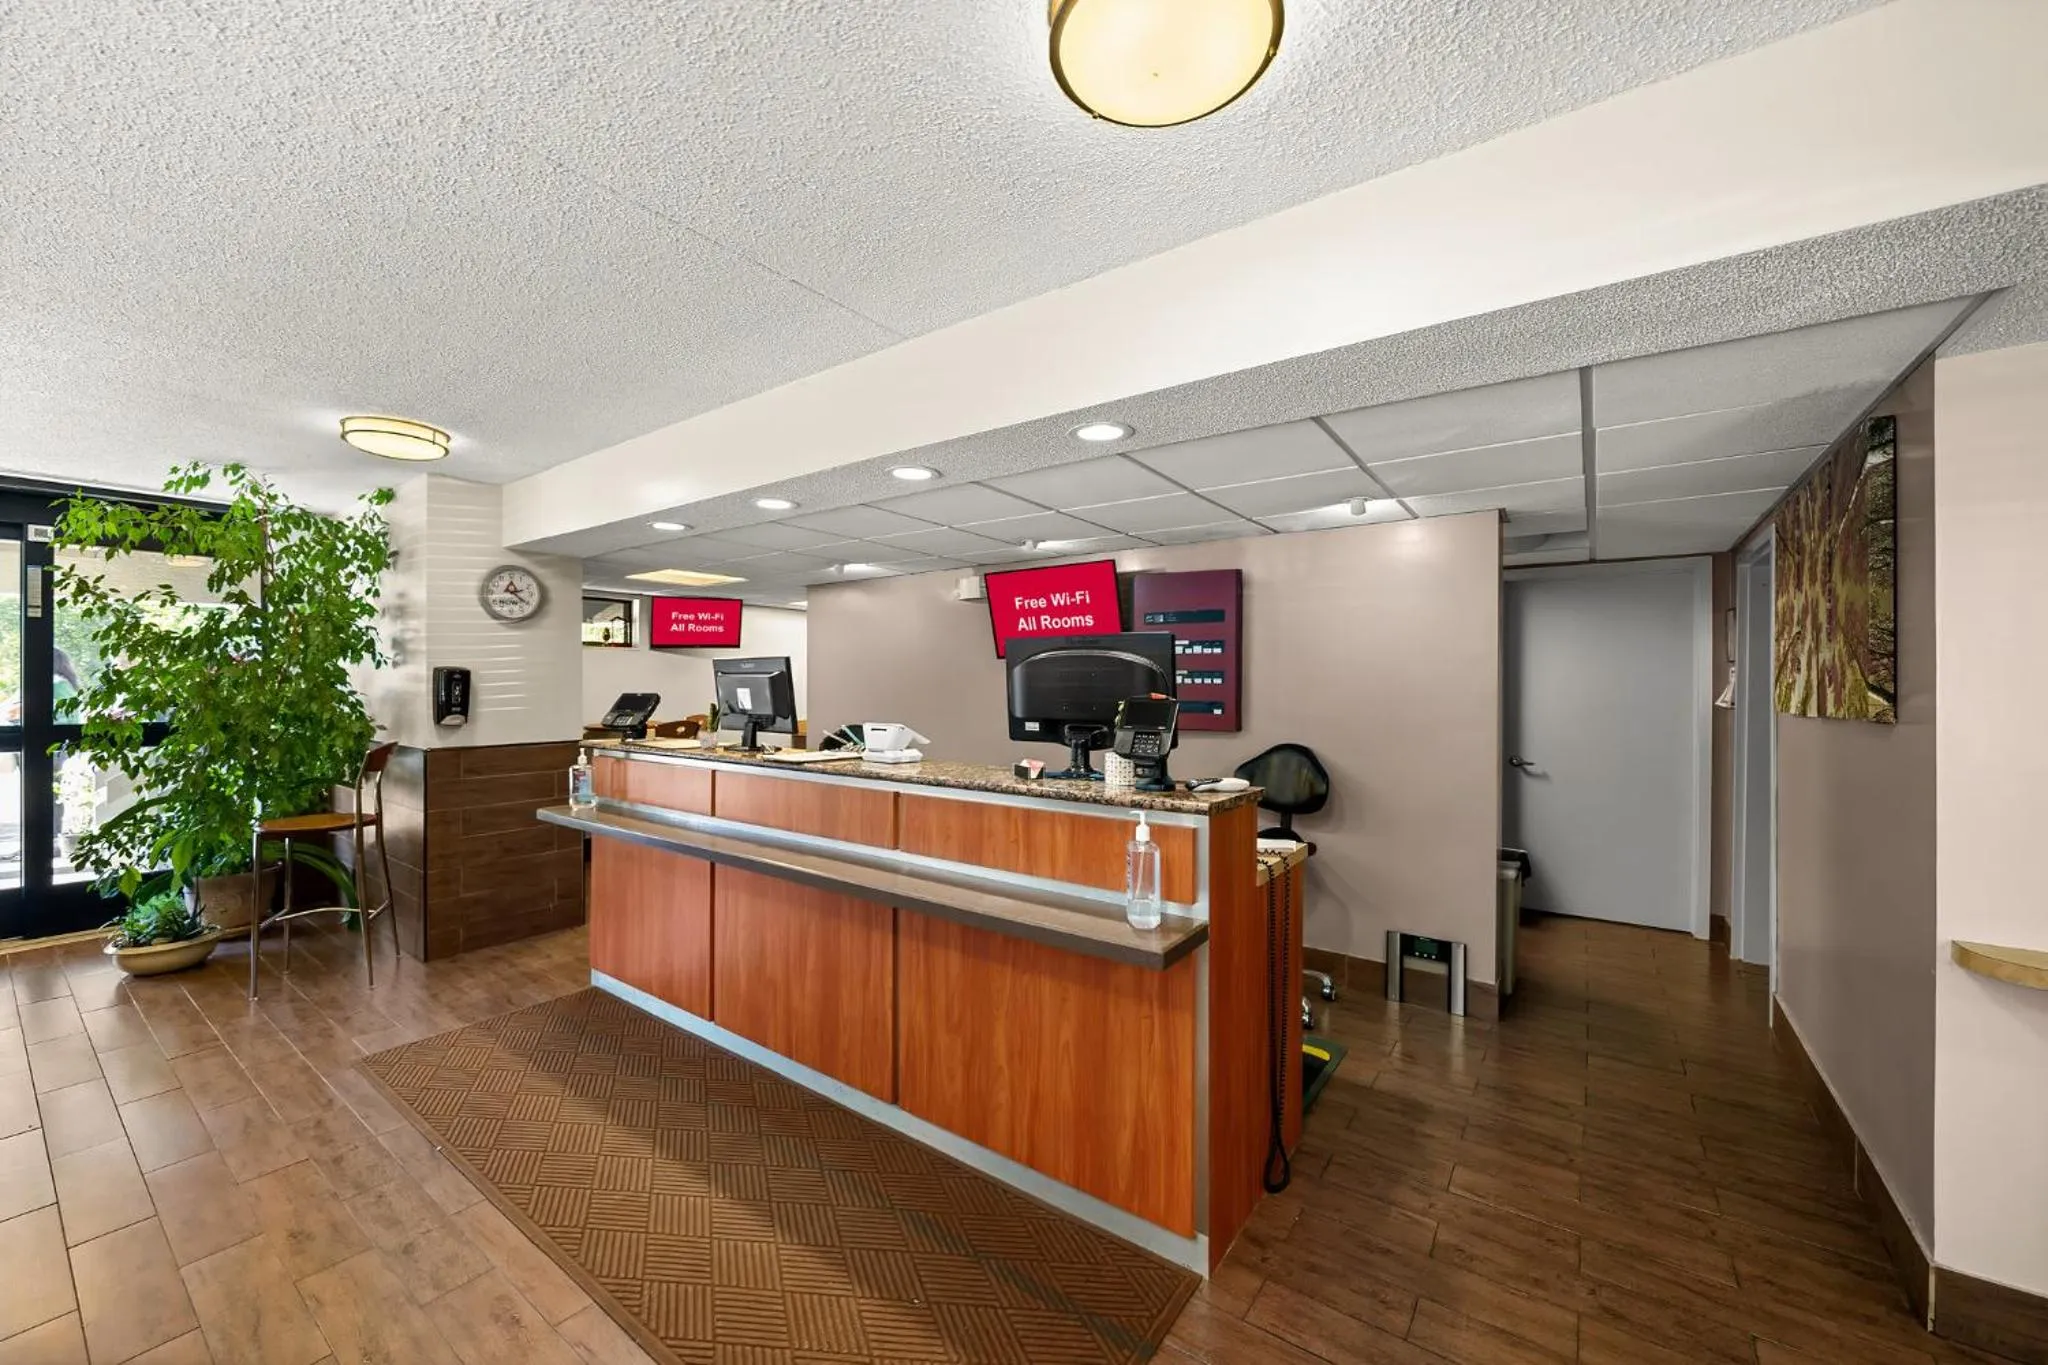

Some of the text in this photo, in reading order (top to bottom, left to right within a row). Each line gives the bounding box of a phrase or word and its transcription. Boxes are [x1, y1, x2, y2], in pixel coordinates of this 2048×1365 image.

[1014, 590, 1090, 610] Free Wi-Fi
[671, 611, 725, 621] Free Wi-Fi
[670, 623, 725, 633] All Rooms
[1018, 615, 1094, 631] All Rooms
